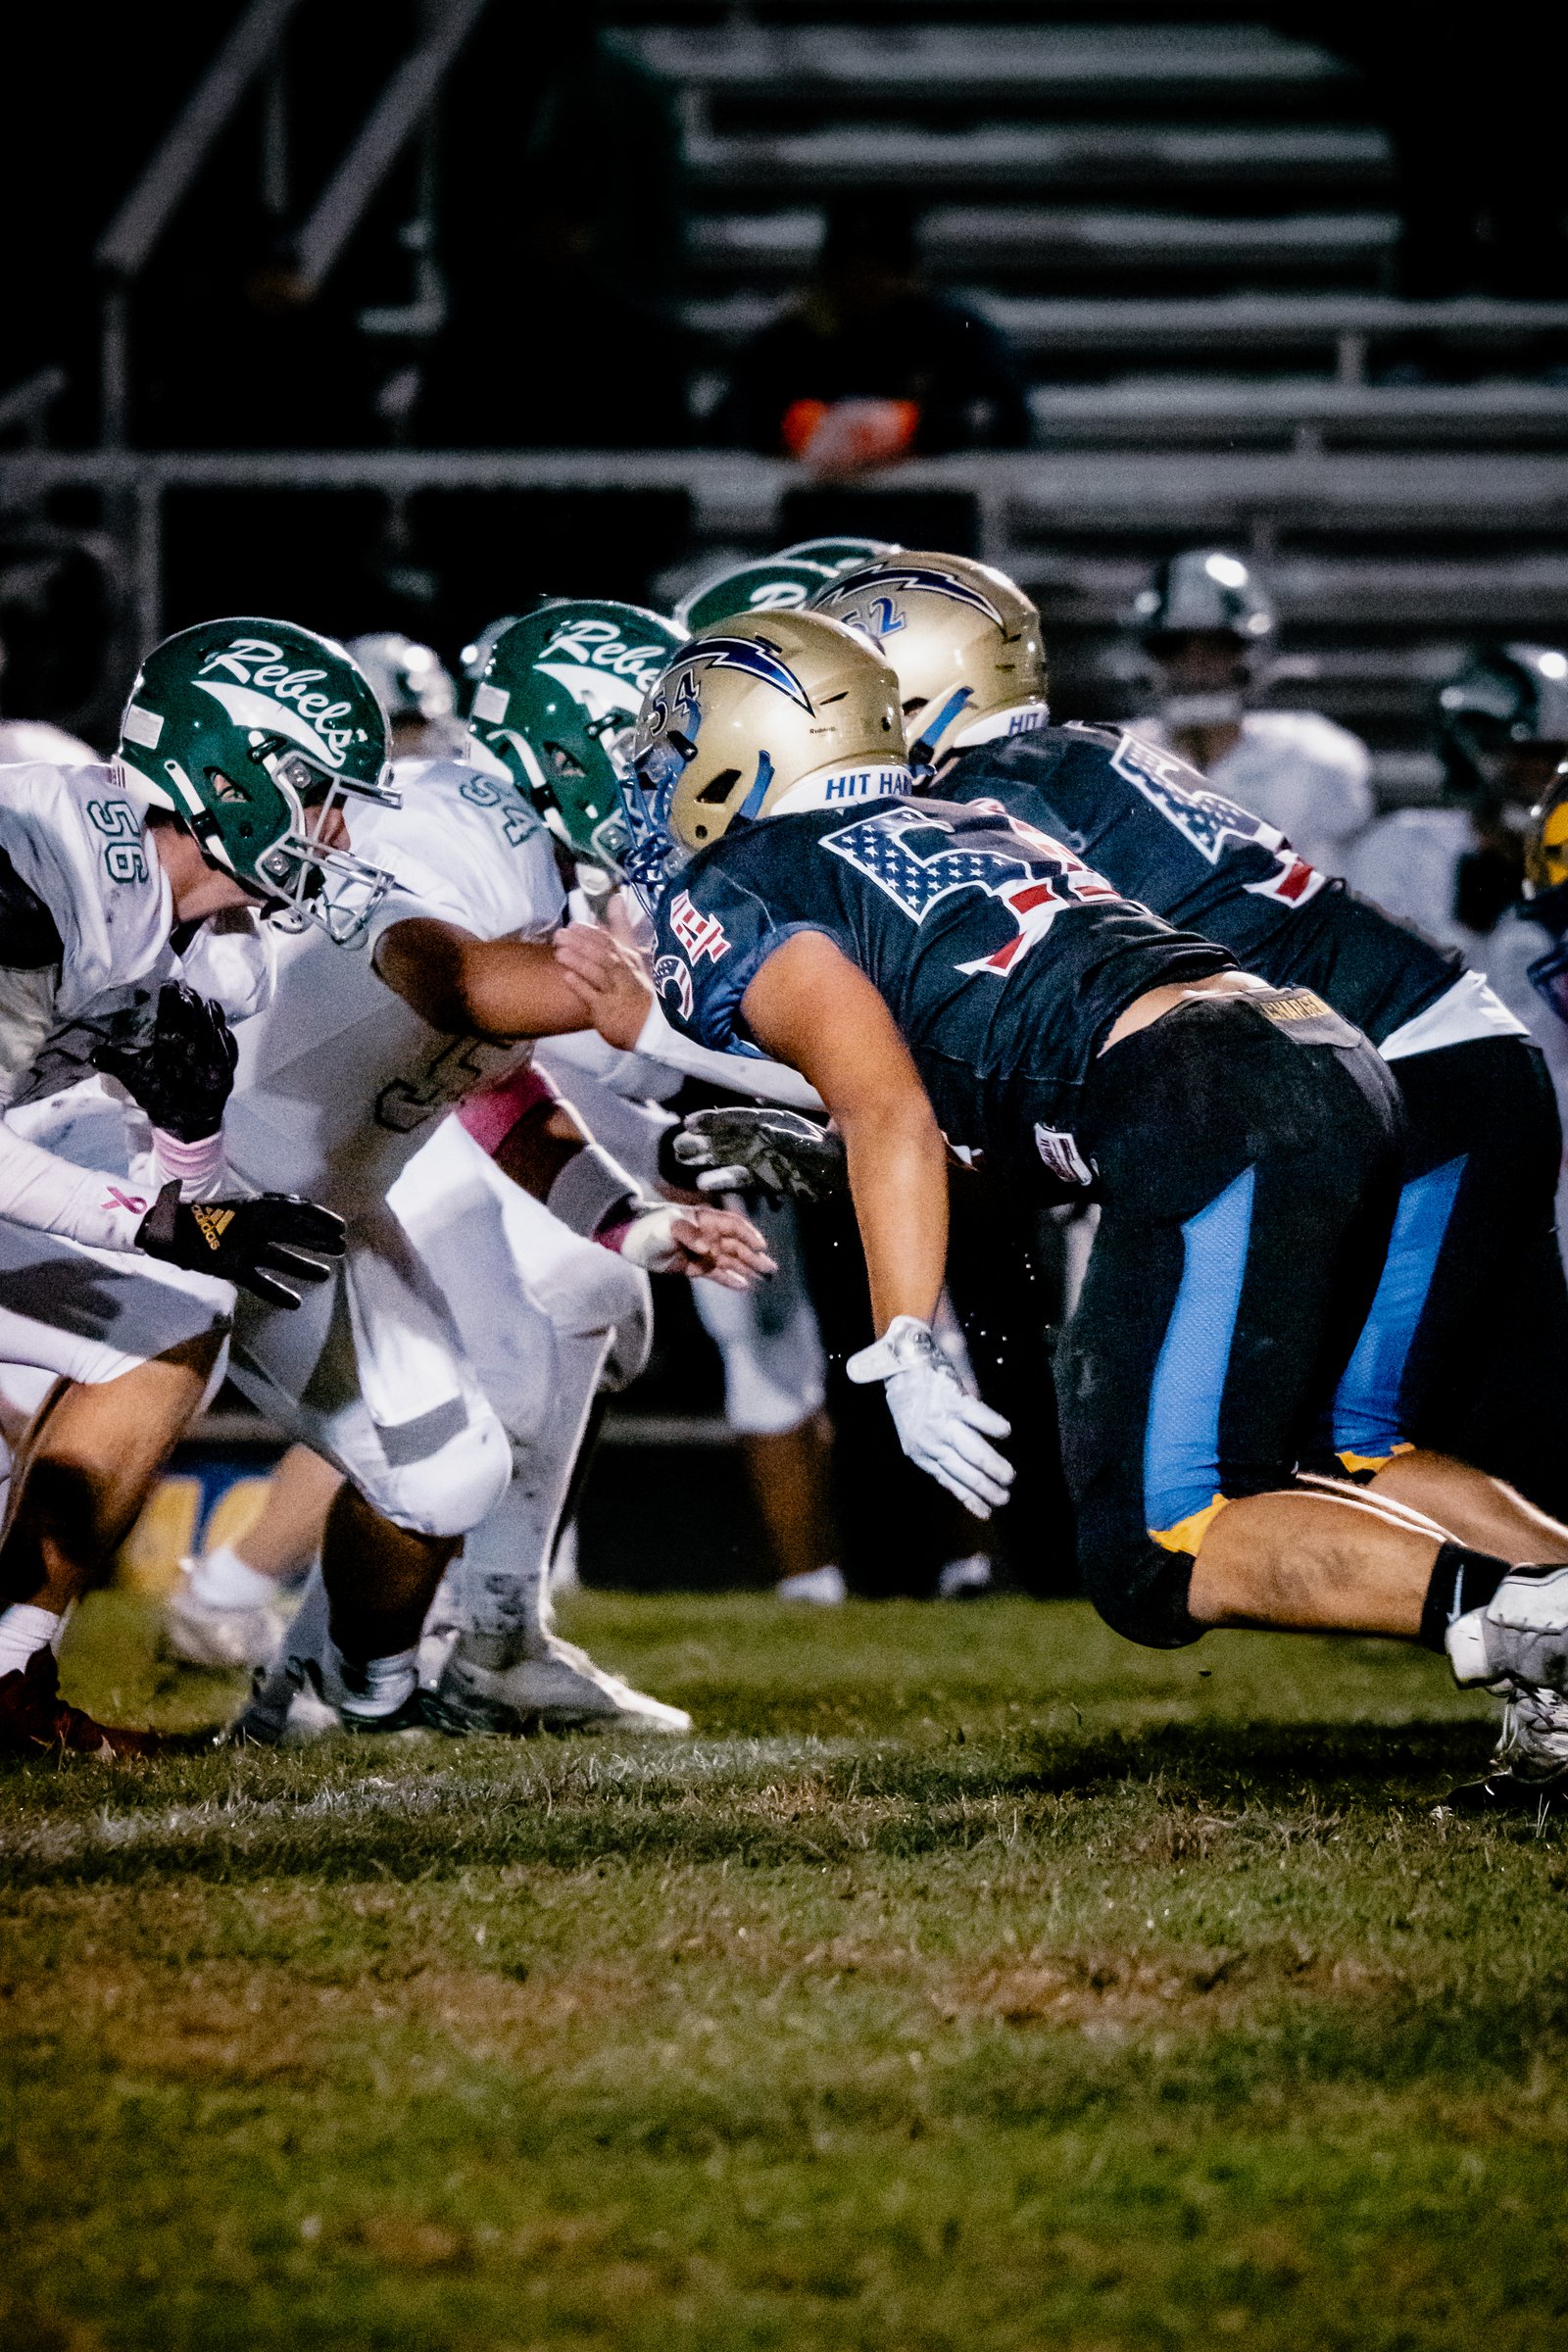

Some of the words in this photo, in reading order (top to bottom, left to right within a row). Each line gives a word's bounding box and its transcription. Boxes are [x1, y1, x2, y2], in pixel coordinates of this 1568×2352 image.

[539, 619, 666, 693] Rebe
[198, 638, 352, 767] Rebels
[648, 667, 702, 738] 54
[1009, 712, 1040, 736] HIT
[824, 772, 871, 801] HIT
[86, 799, 150, 884] 56
[191, 1204, 220, 1250] adidas
